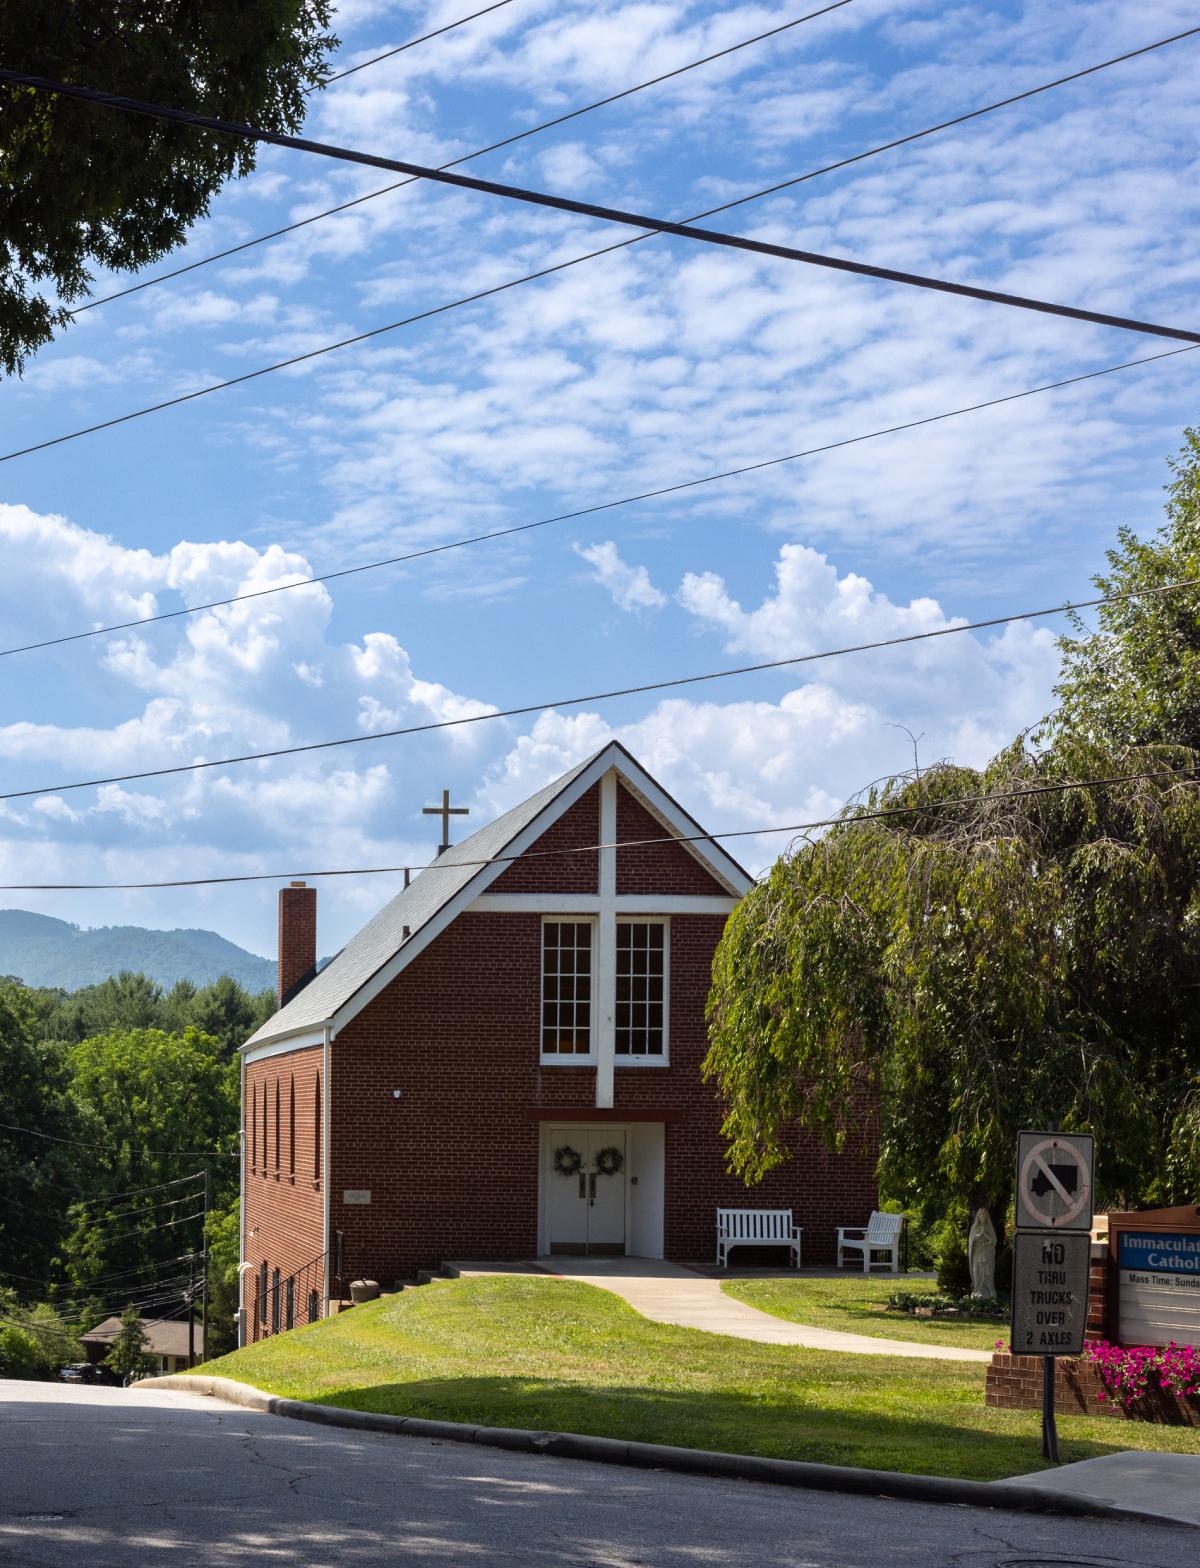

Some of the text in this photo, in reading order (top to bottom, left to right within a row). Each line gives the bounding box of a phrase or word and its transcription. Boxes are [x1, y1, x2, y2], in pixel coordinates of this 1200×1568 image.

[1041, 1241, 1065, 1265] NO
[1037, 1270, 1066, 1285] THRU
[1129, 1273, 1149, 1284] Mass
[1152, 1275, 1173, 1286] Time:
[1030, 1290, 1072, 1305] TRUCKS
[1036, 1310, 1065, 1326] OVER
[1026, 1331, 1072, 1345] 2 AXLES
